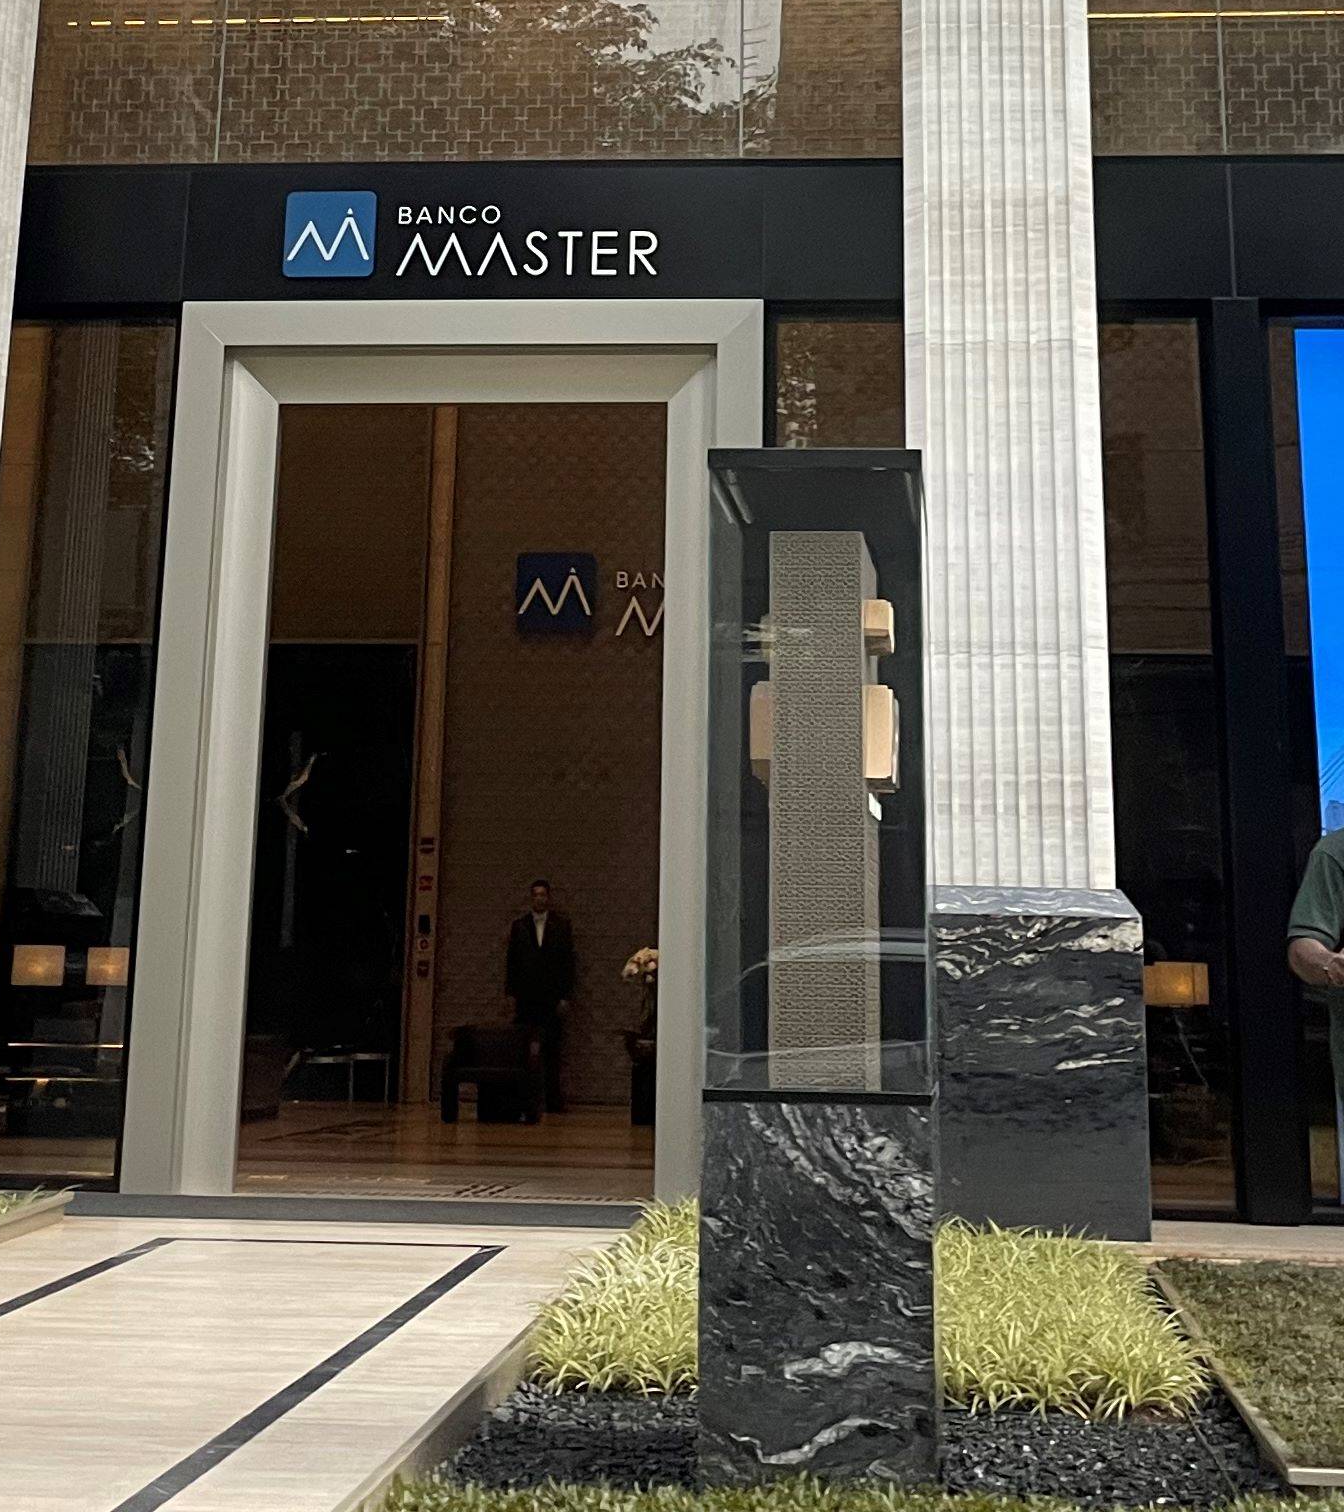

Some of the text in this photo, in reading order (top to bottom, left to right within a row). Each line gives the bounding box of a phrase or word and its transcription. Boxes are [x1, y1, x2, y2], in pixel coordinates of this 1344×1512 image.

[398, 205, 501, 225] BANCO
[396, 230, 658, 276] MASTER
[616, 571, 664, 589] BAN
